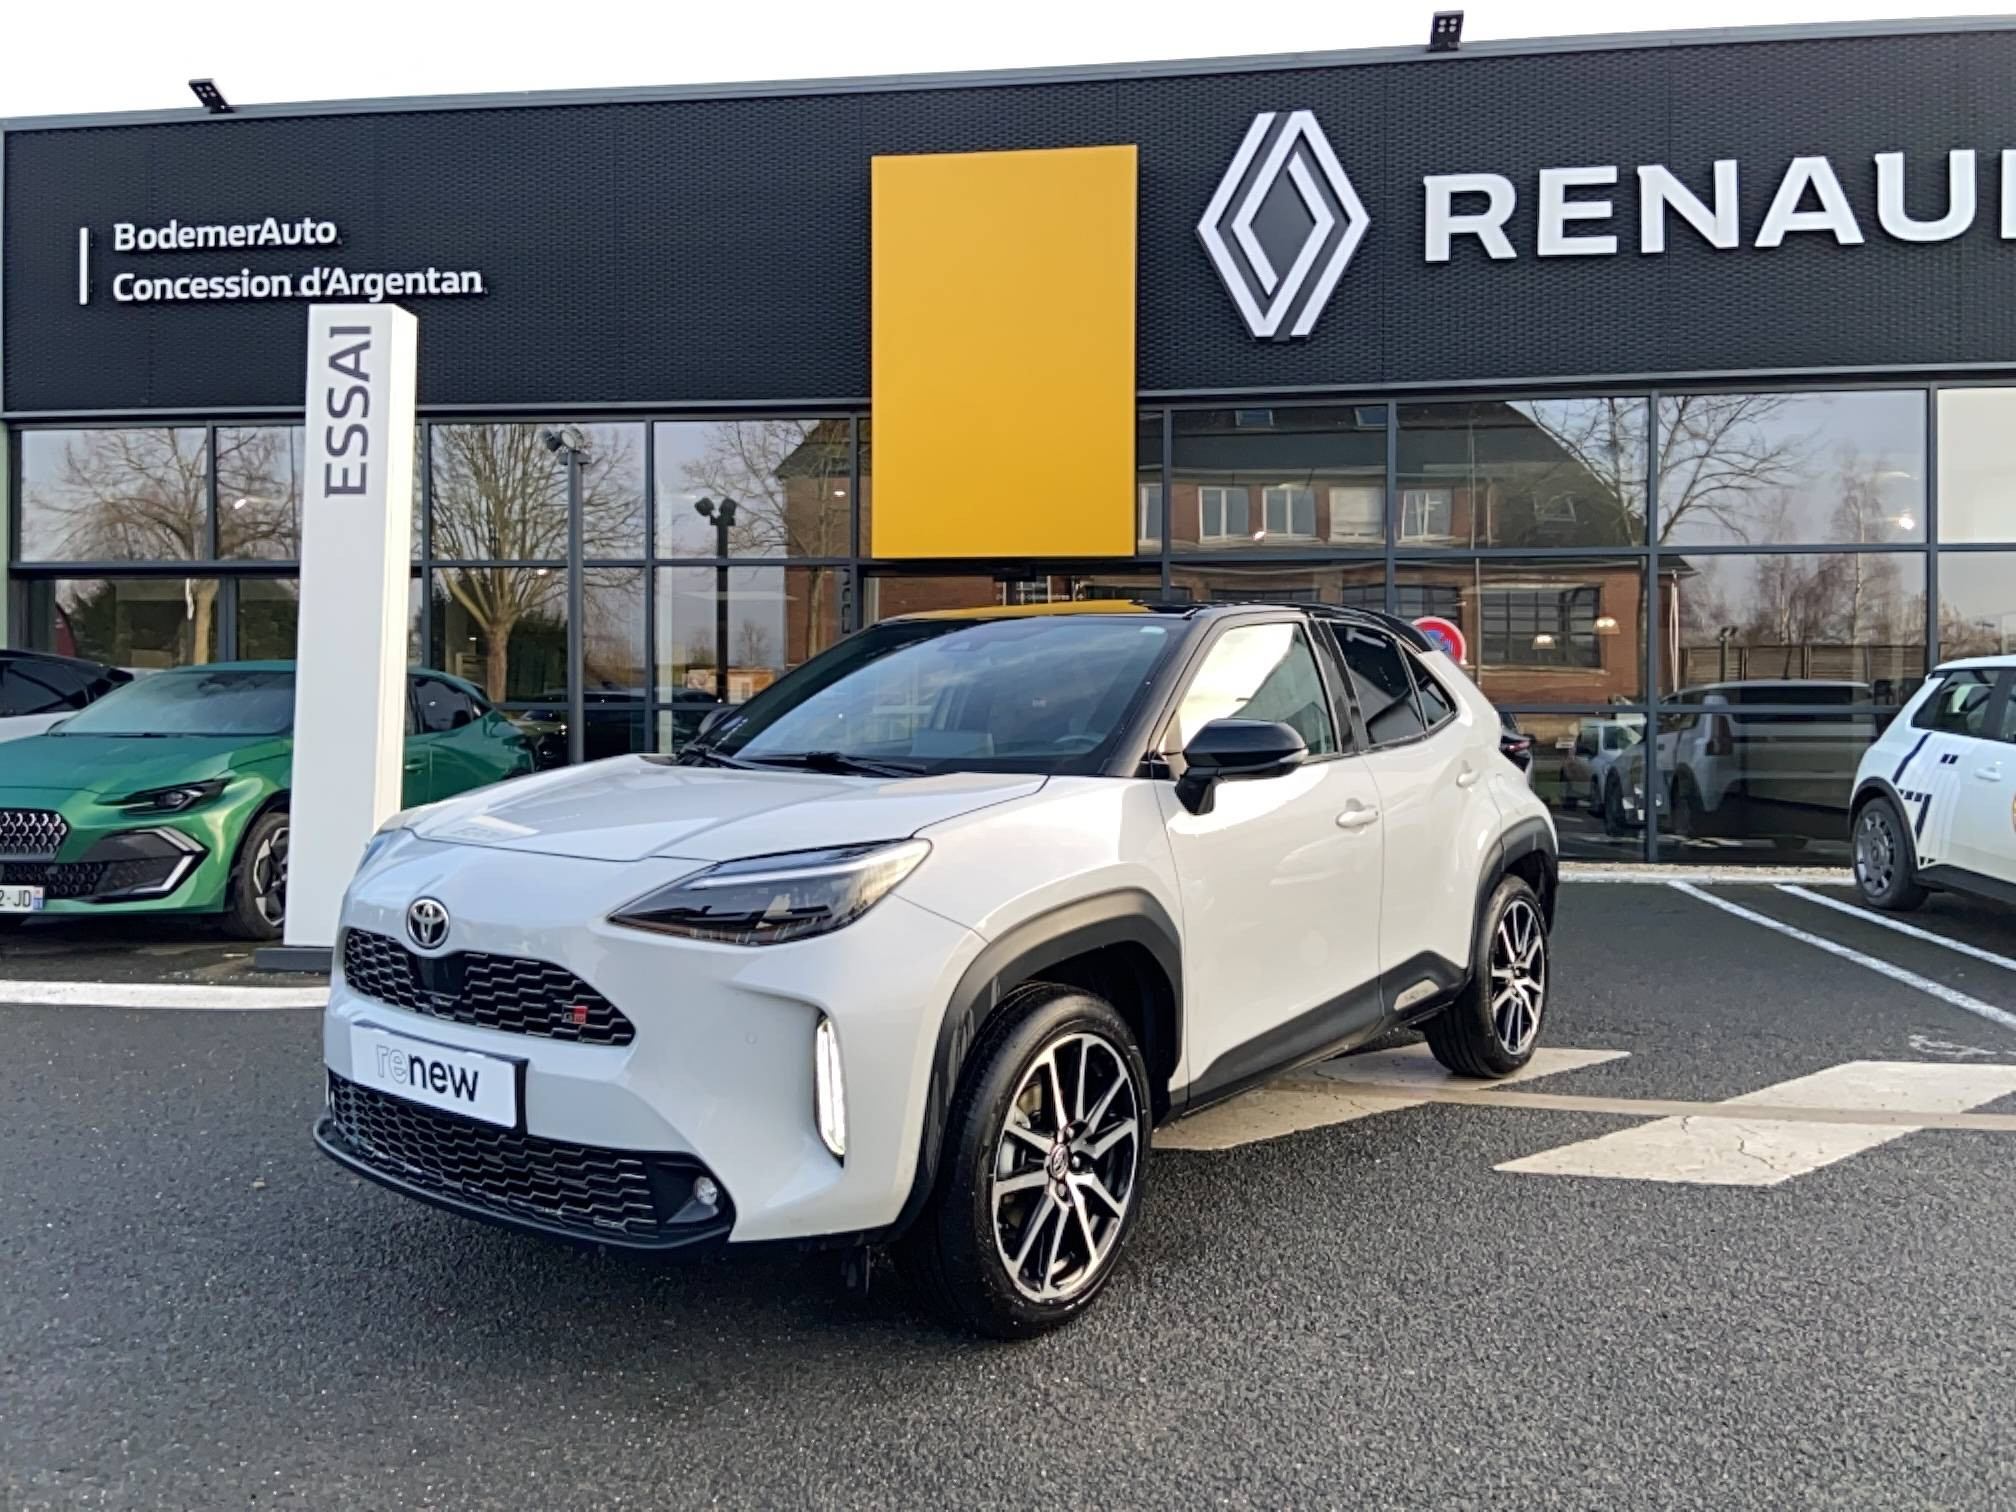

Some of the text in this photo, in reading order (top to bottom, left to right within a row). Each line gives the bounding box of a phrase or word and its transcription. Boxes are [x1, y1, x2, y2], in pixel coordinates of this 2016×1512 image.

[113, 217, 337, 251] BodemerAuto
[1423, 149, 2016, 262] RENAU
[113, 266, 482, 303] Concession d'Argentan
[324, 325, 372, 498] ESSAI
[376, 1045, 479, 1102] renew
